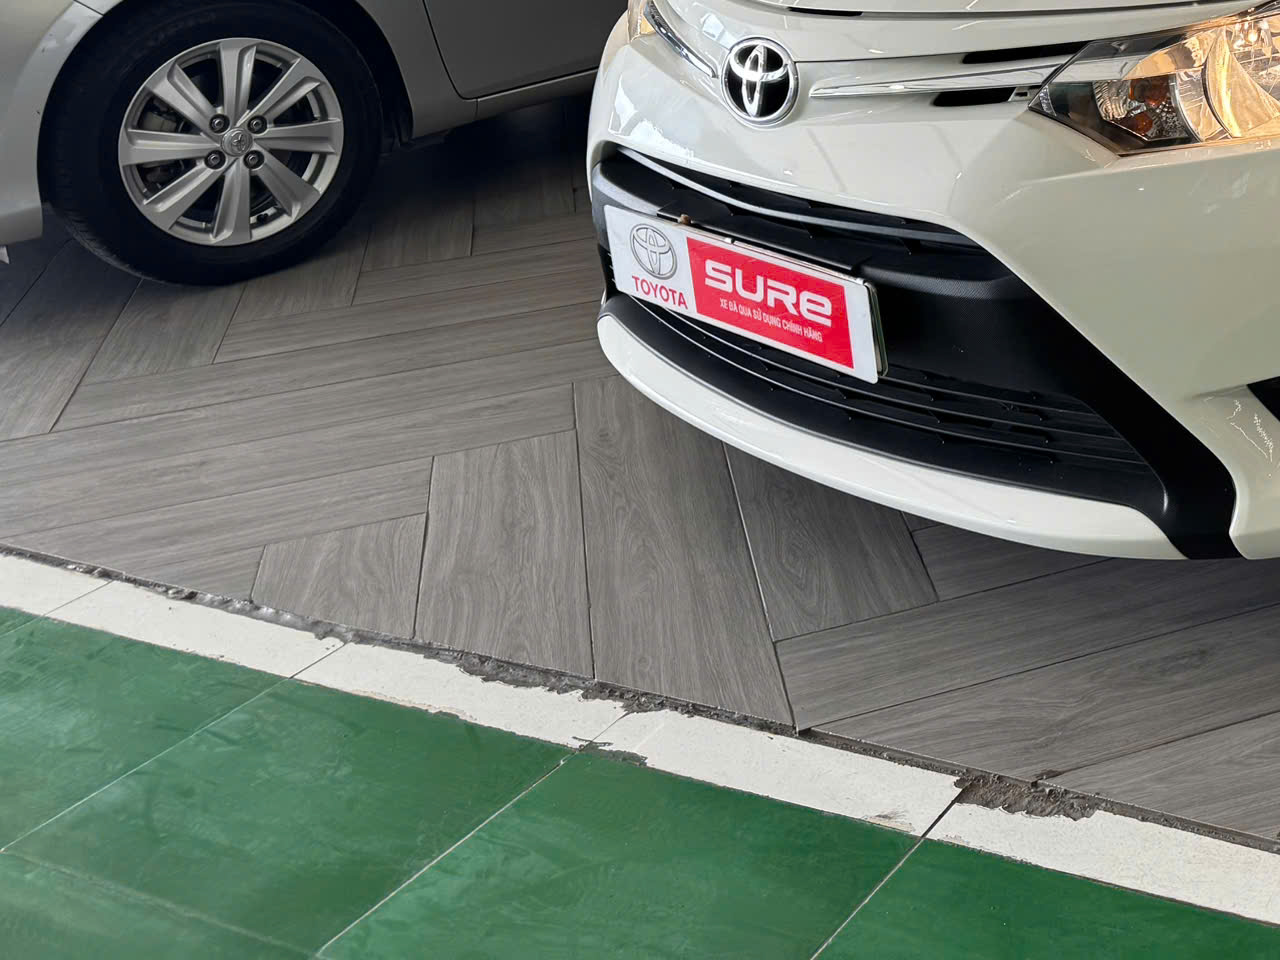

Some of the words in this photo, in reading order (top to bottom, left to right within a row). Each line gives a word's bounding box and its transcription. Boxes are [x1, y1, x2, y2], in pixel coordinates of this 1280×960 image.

[631, 275, 689, 310] TOYOTA
[719, 297, 729, 310] XE
[738, 304, 753, 318] QUA
